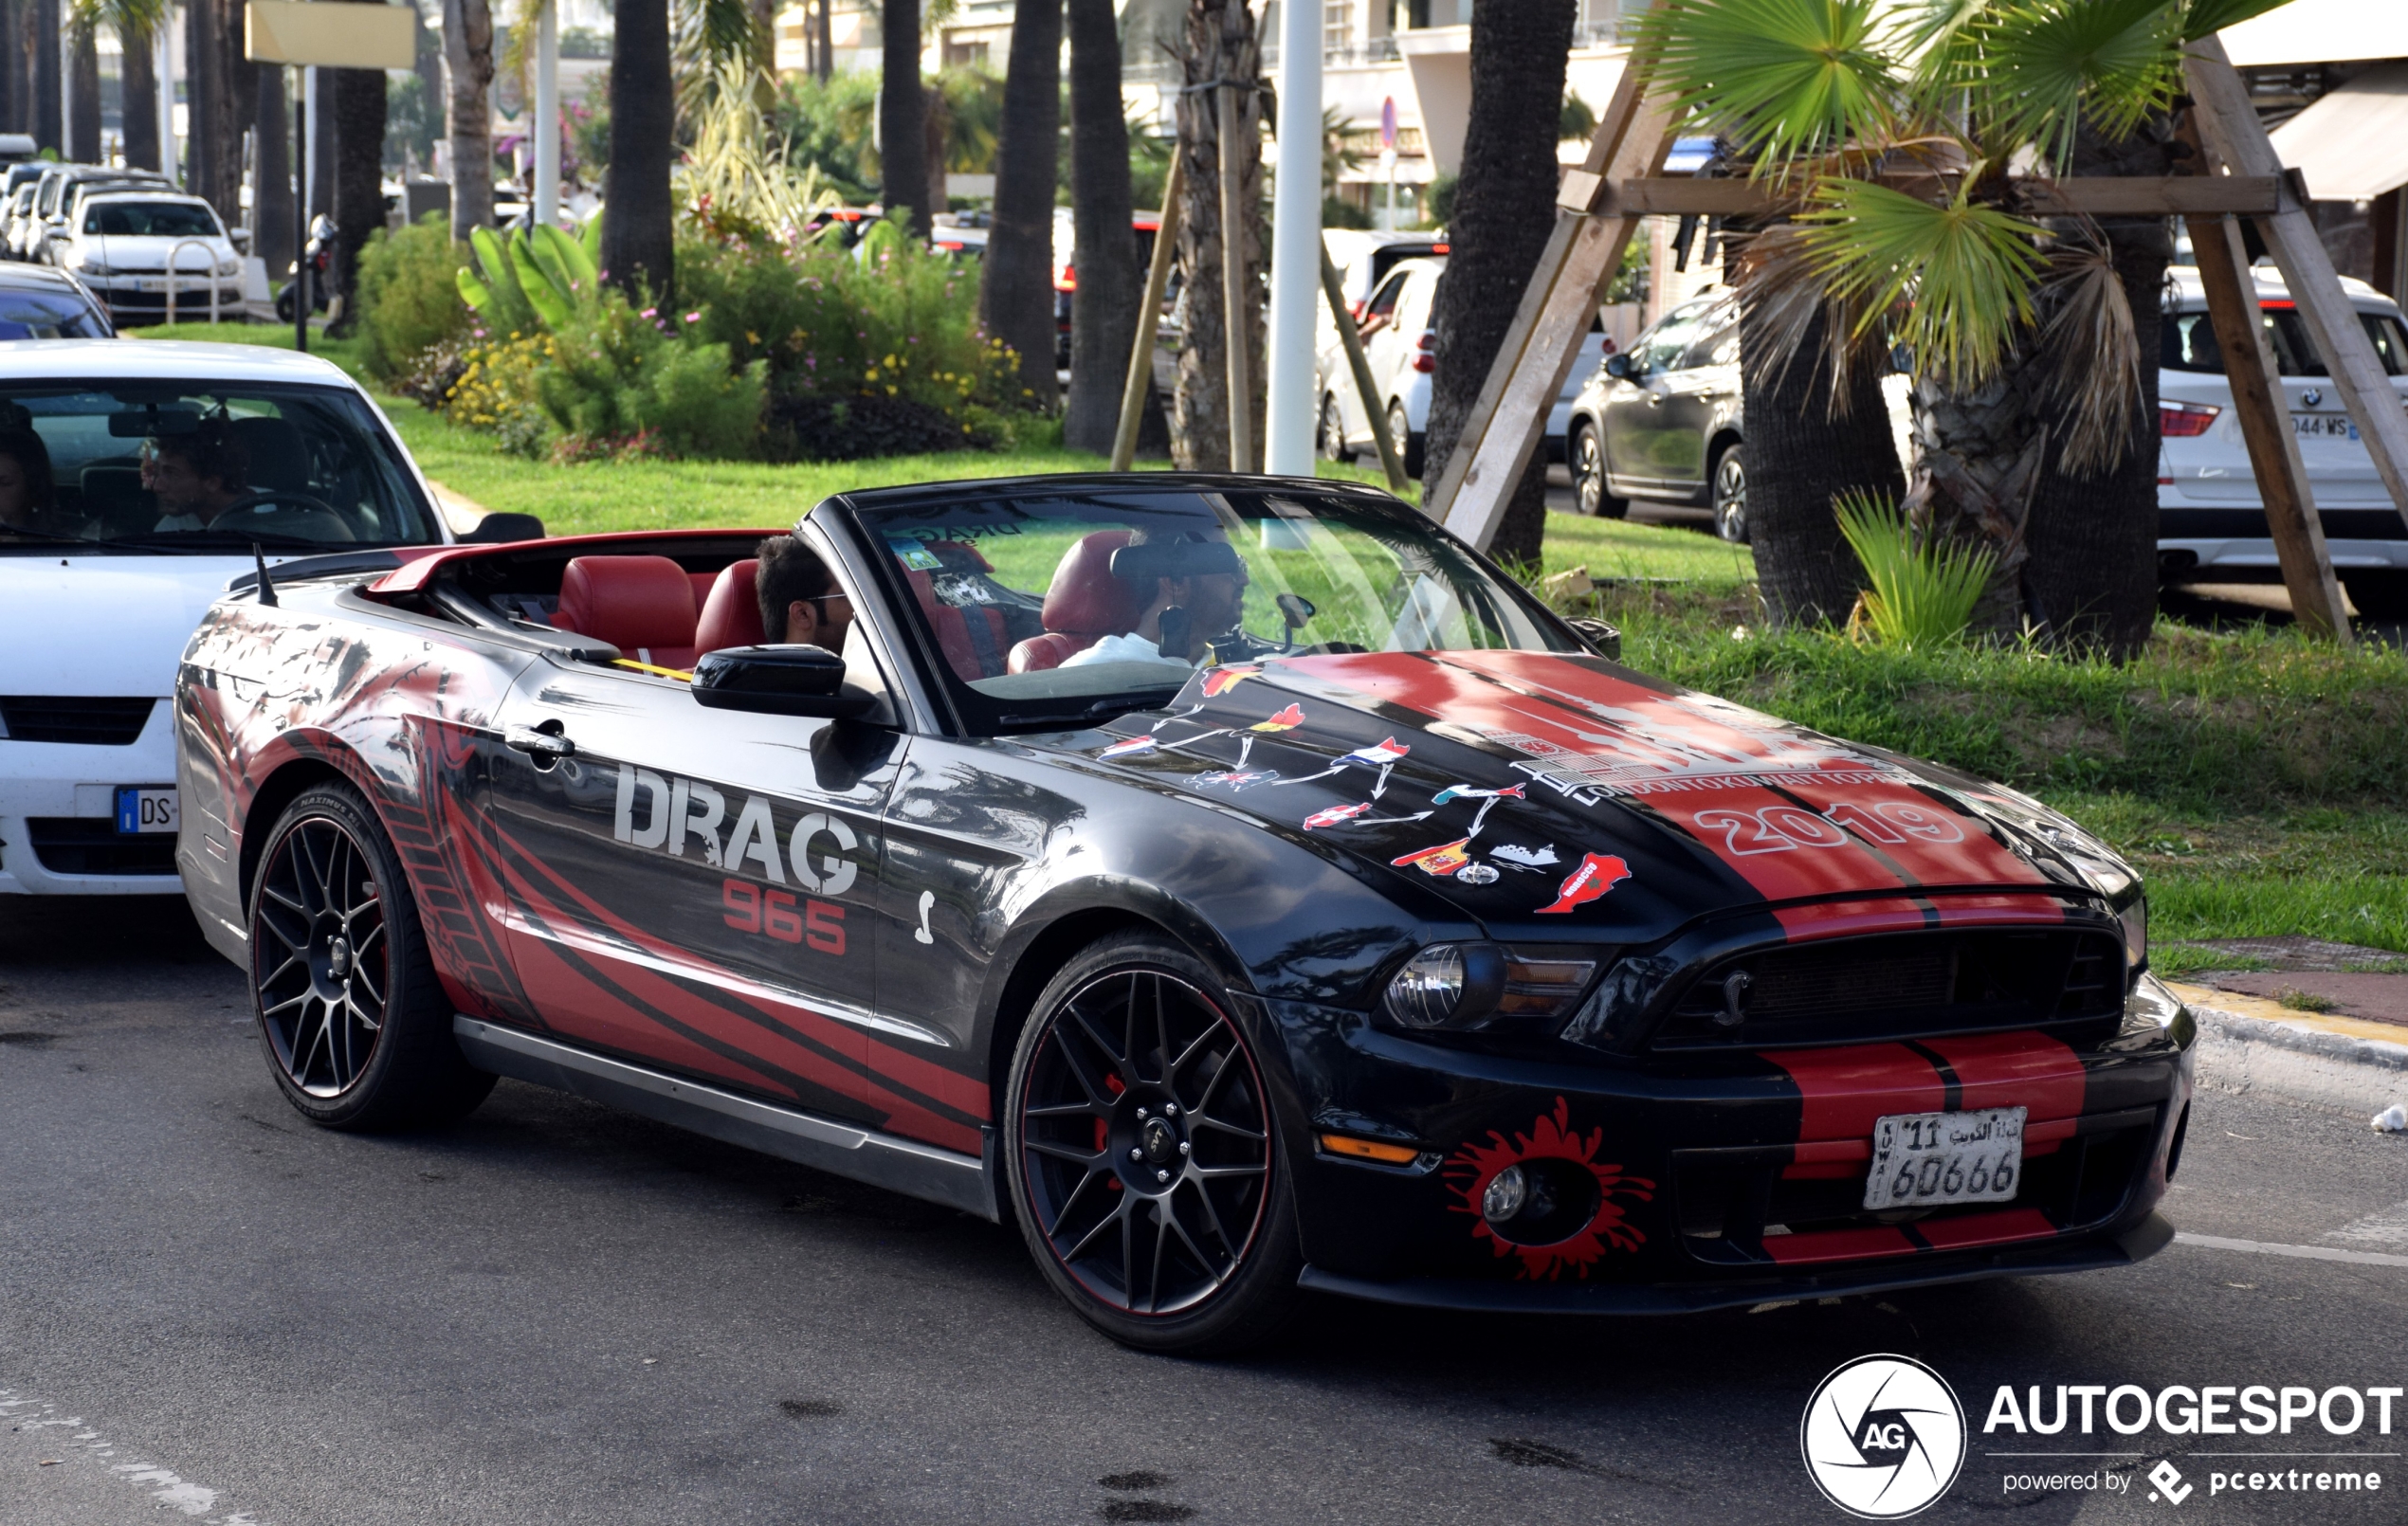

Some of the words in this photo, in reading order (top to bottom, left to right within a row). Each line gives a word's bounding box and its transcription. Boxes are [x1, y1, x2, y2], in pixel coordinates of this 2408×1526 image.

[141, 798, 171, 824] DS
[614, 763, 858, 895] DRAG
[1693, 802, 1965, 856] 2019
[1563, 862, 1598, 898] MOROCCO
[722, 878, 846, 955] 965
[1907, 1118, 1940, 1151] 11
[1891, 1151, 2016, 1199] 60666
